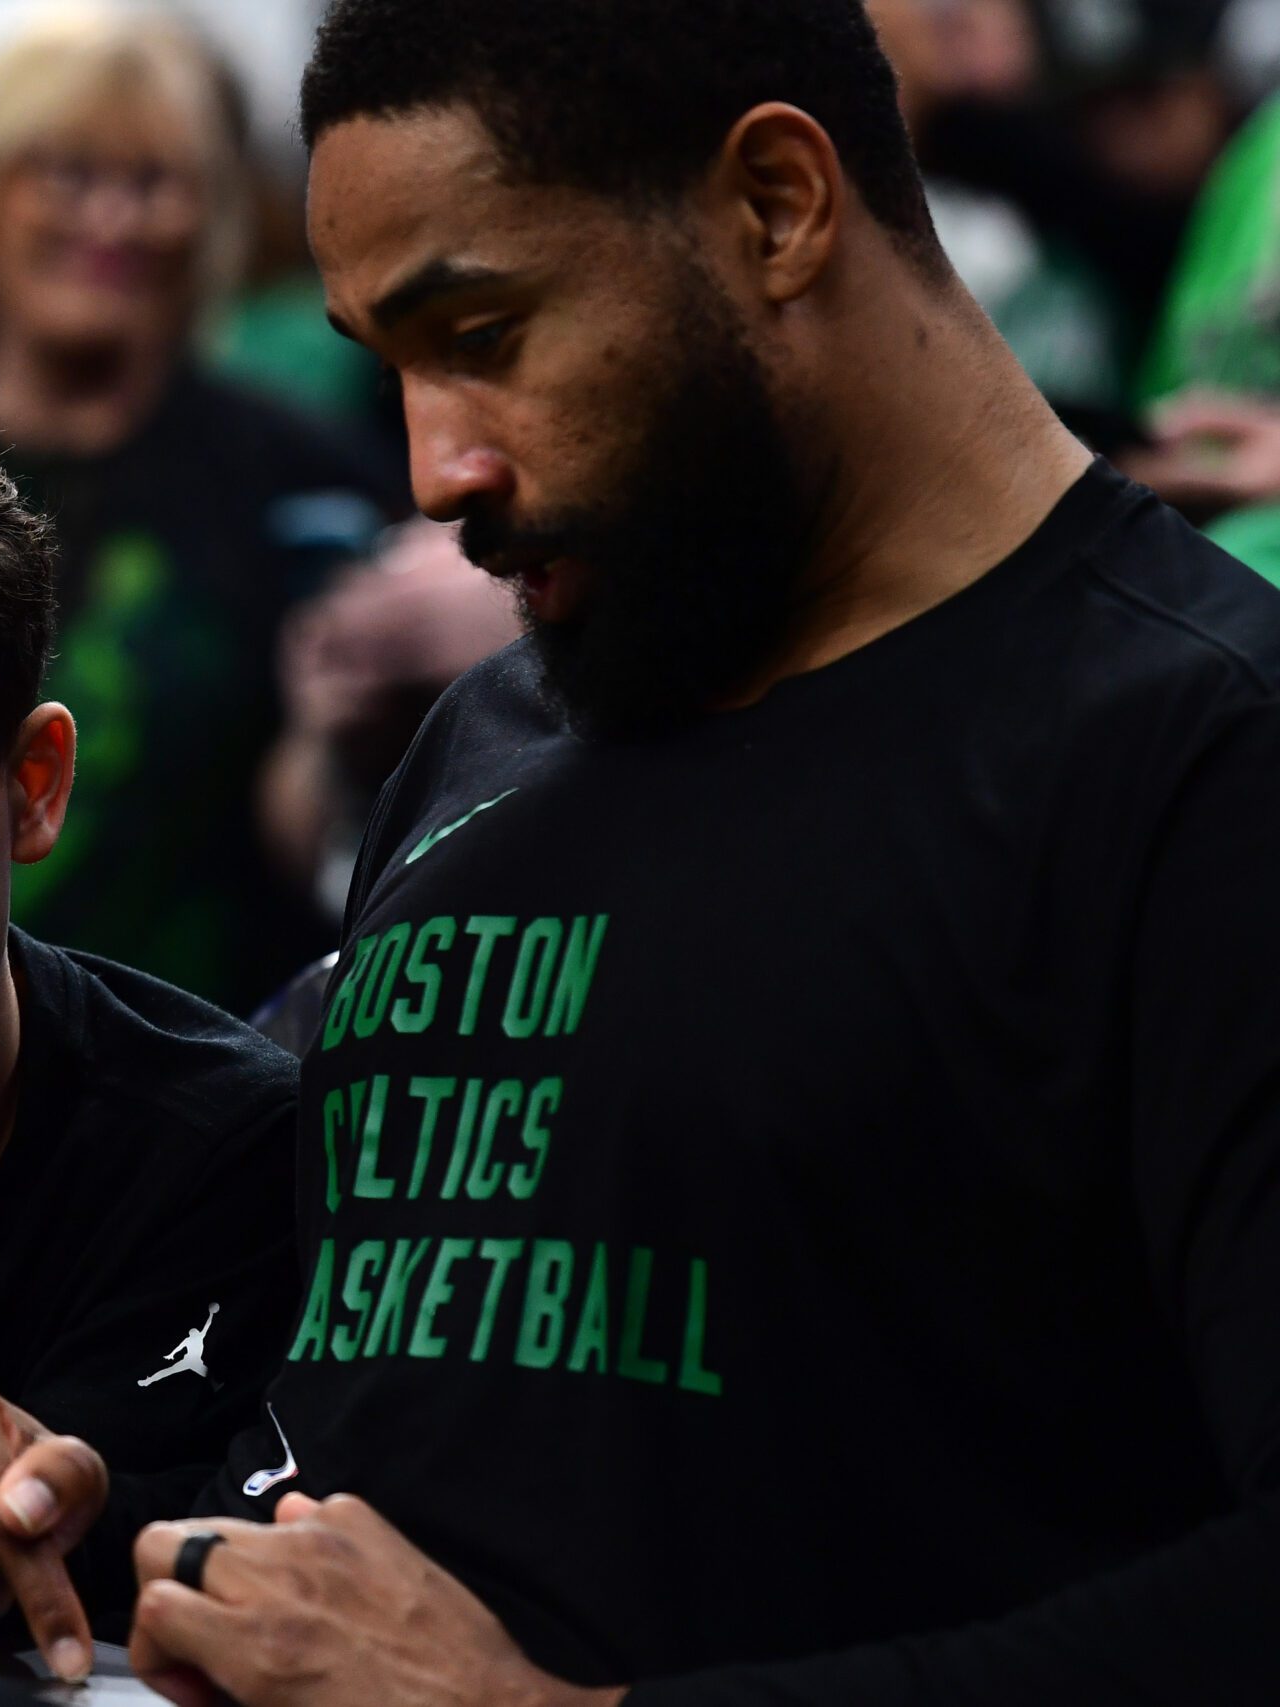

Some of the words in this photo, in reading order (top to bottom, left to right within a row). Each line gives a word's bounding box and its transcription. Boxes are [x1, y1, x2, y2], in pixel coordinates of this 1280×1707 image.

[322, 913, 608, 1051] BOSTON
[323, 1074, 563, 1213] CLTICS
[288, 1237, 721, 1395] ASKETBALL
